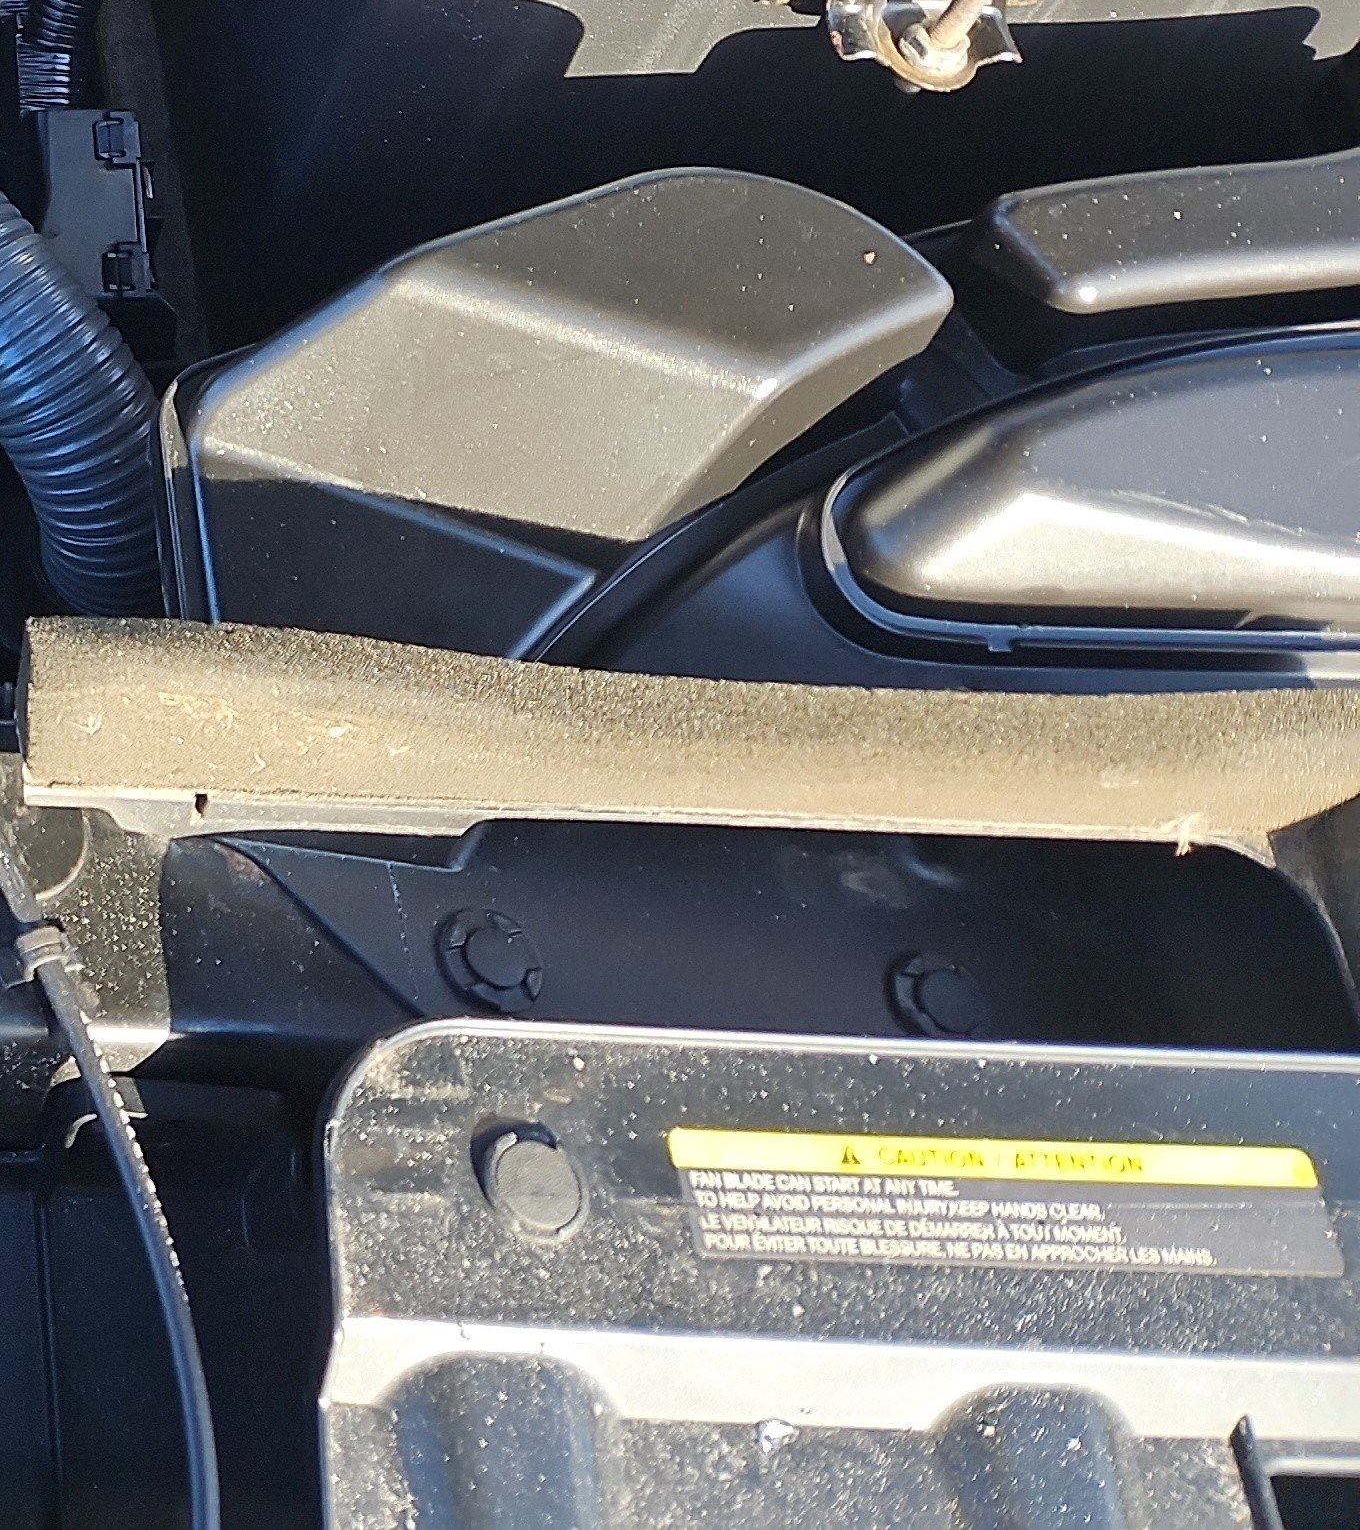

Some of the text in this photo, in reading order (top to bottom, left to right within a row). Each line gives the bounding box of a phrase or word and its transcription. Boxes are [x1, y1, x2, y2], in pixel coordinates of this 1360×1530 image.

[689, 1170, 722, 1189] FAN
[722, 1172, 776, 1191] BLADE
[776, 1173, 811, 1192] CAN
[812, 1174, 862, 1193] START
[884, 1178, 917, 1196] ANY
[694, 1190, 718, 1209] TO
[719, 1191, 760, 1211] HELP
[761, 1192, 812, 1211] AVOID
[811, 1194, 896, 1215] PERSONAL
[991, 1201, 1049, 1220] HANDS
[699, 1213, 721, 1232] LE
[822, 1217, 884, 1237] RISQUE
[884, 1219, 908, 1238] DE
[1011, 1223, 1051, 1242] TOUT
[703, 1232, 751, 1251] POUR
[806, 1235, 859, 1255] TOUTE
[947, 1241, 971, 1259] NE
[972, 1243, 1004, 1260] PAS
[1004, 1243, 1029, 1261] EN
[1031, 1244, 1130, 1263] APPROCHER
[1129, 1247, 1161, 1265] LES
